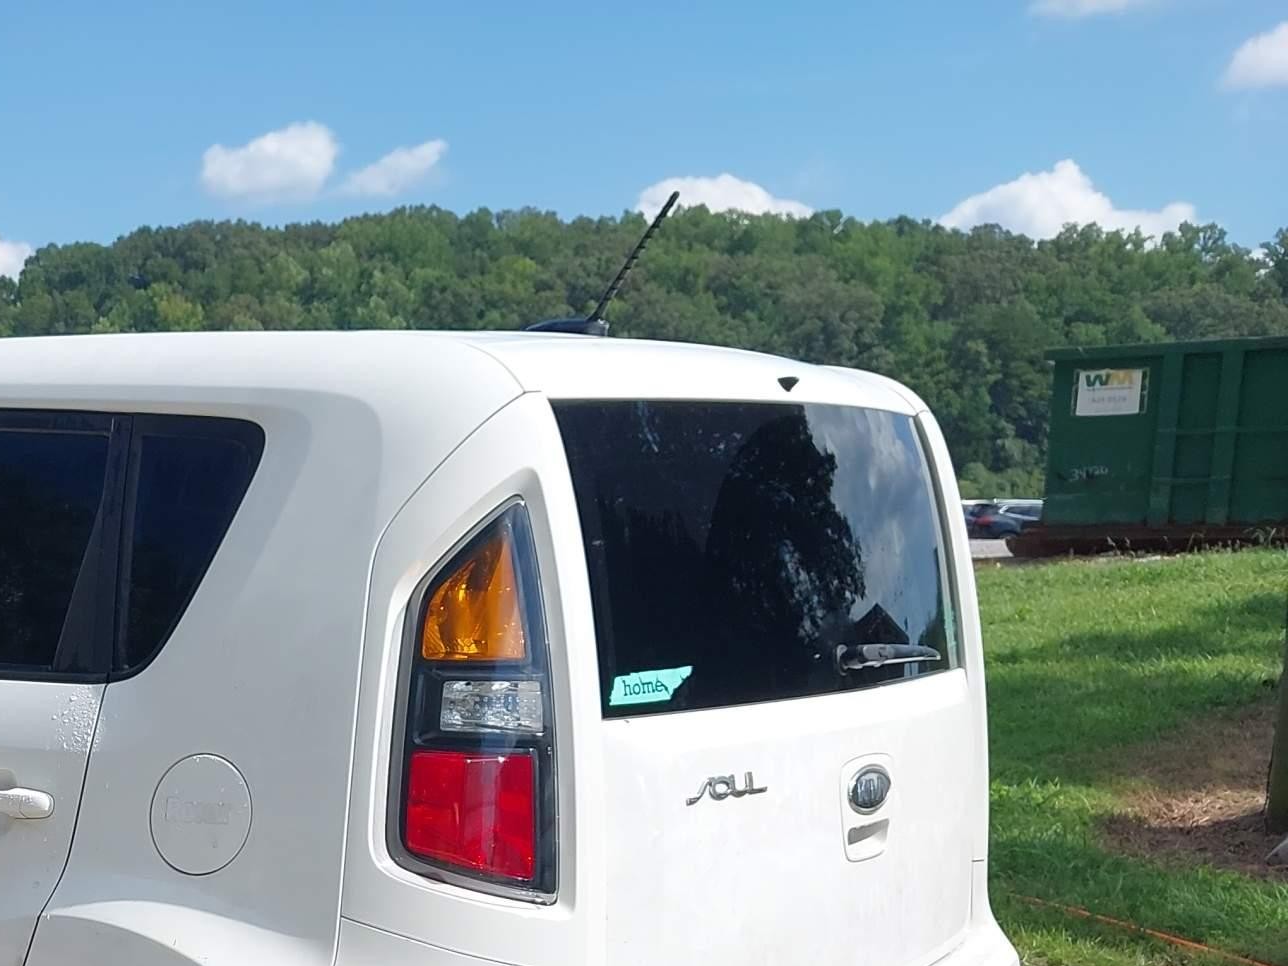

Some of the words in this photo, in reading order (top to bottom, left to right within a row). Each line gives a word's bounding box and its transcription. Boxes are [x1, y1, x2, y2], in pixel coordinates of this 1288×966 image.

[1085, 370, 1133, 387] WM
[623, 676, 664, 697] home
[686, 771, 767, 806] SOUL
